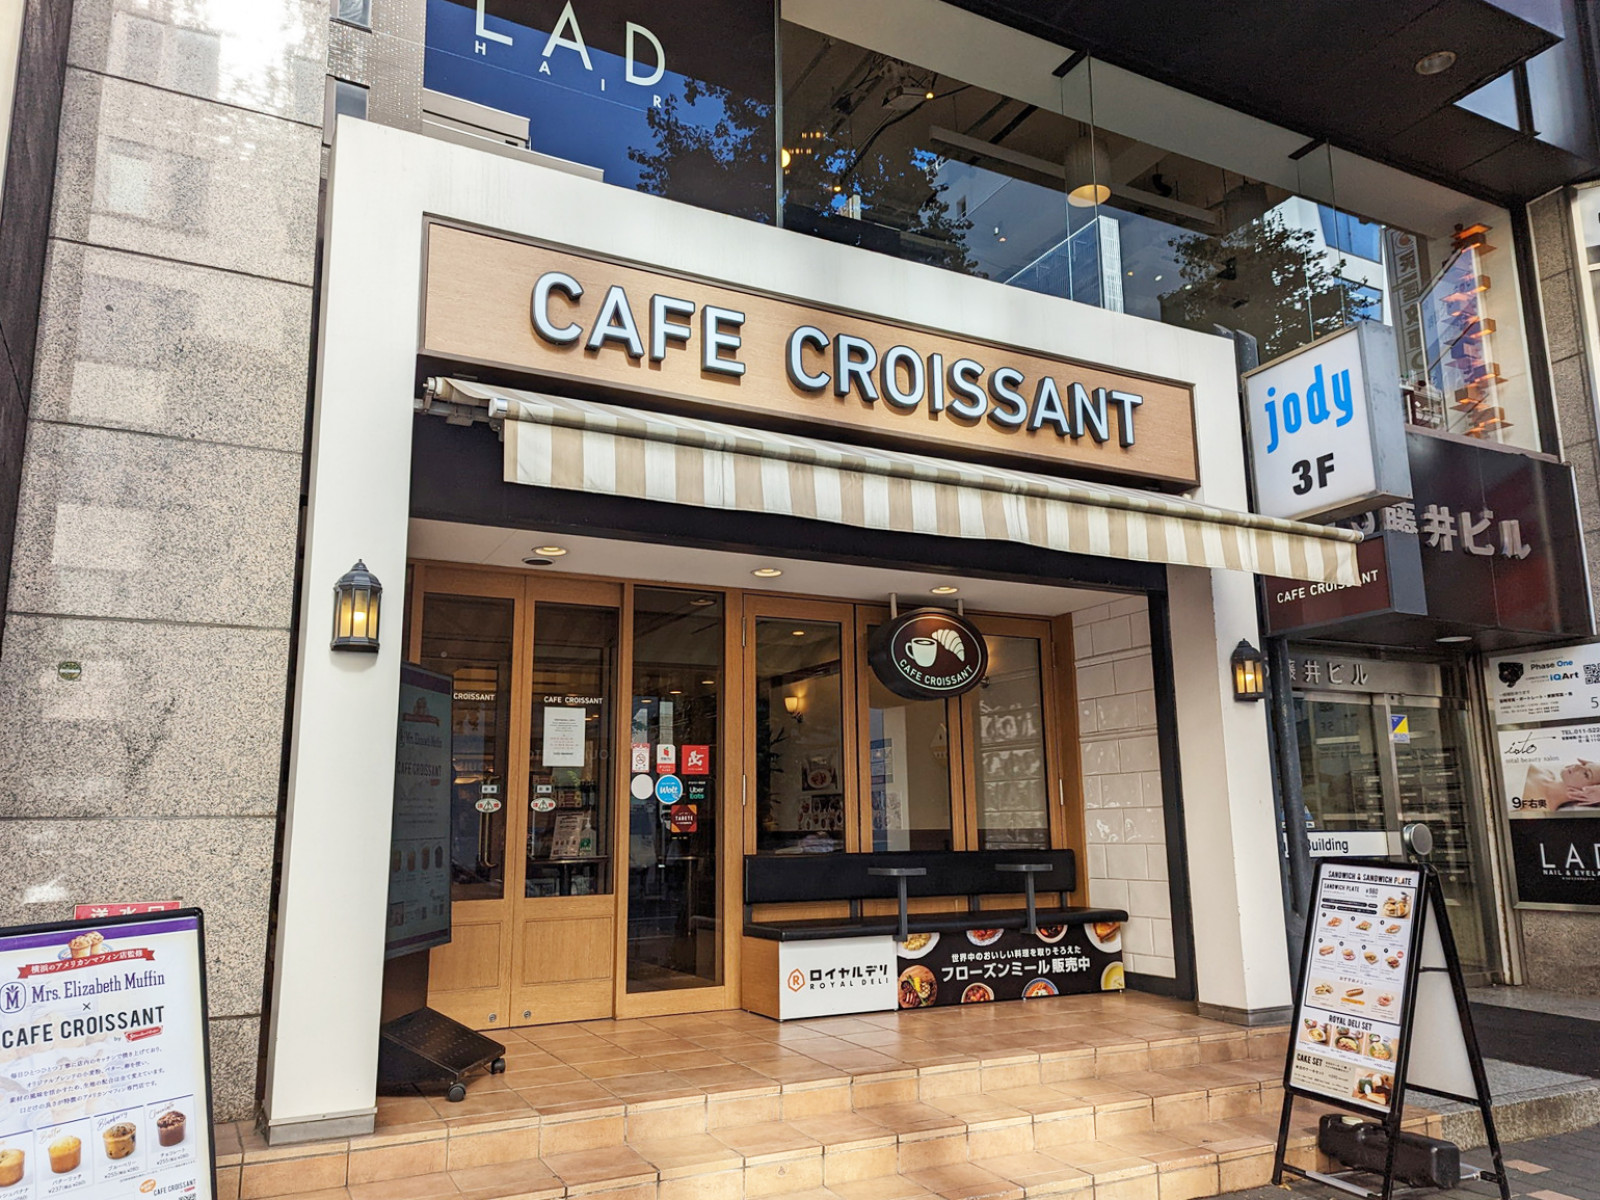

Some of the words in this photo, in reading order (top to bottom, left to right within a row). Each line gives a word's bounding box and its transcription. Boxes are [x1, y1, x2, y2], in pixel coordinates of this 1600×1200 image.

[475, 0, 666, 86] LAD
[531, 271, 746, 377] CAFE
[786, 325, 1144, 448] CROISSANT
[1263, 364, 1355, 454] jody
[1291, 452, 1336, 496] 3F
[1276, 587, 1306, 604] CAFE
[899, 658, 923, 681] CAFE
[924, 664, 974, 686] CROISSANT
[1530, 663, 1556, 671] Phase
[453, 692, 496, 701] CROISSANT
[543, 695, 563, 704] CAFE
[564, 696, 603, 705] CROISSANT
[660, 785, 679, 794] Wolt
[1328, 870, 1356, 880] SANDWICH
[1362, 874, 1393, 884] SANDWICH
[1393, 877, 1412, 885] PLATE
[1324, 882, 1346, 891] SANDWICH
[951, 944, 1082, 963] 世界中のおいしい料理を取りそろえた
[809, 964, 888, 982] ロイヤルデリ
[32, 984, 61, 1003] Mrs.
[64, 976, 122, 999] Elizabeth
[124, 969, 165, 991] Muffin
[809, 979, 854, 990] ROYAL
[861, 977, 888, 985] DELI
[2, 1023, 53, 1049] CAFE
[60, 1005, 165, 1040] CROISSANT
[1329, 1014, 1347, 1027] ROYAL
[1347, 1018, 1361, 1029] DELI
[1361, 1021, 1373, 1031] SET
[1297, 1053, 1311, 1064] CAKE
[1312, 1057, 1323, 1067] SET
[153, 1186, 167, 1196] CAFE
[167, 1178, 196, 1192] CROISSANT
